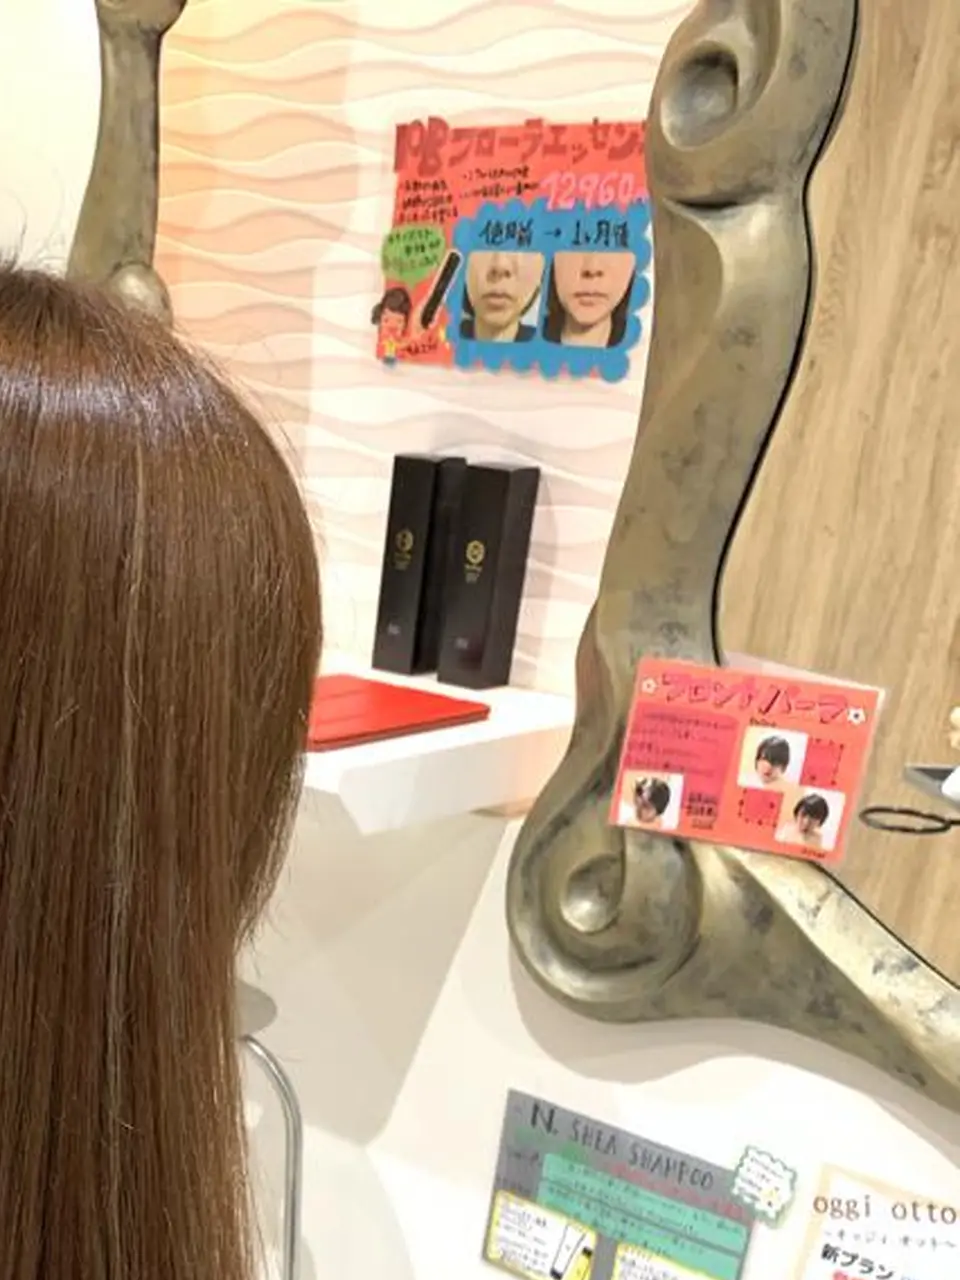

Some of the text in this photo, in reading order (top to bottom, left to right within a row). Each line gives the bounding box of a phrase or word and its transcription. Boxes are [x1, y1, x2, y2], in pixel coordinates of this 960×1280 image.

[571, 1120, 617, 1156] SHEA
[628, 1141, 714, 1191] SHAMPOO
[813, 1194, 957, 1225] oggi otto
[821, 1243, 895, 1280] 新プラン
